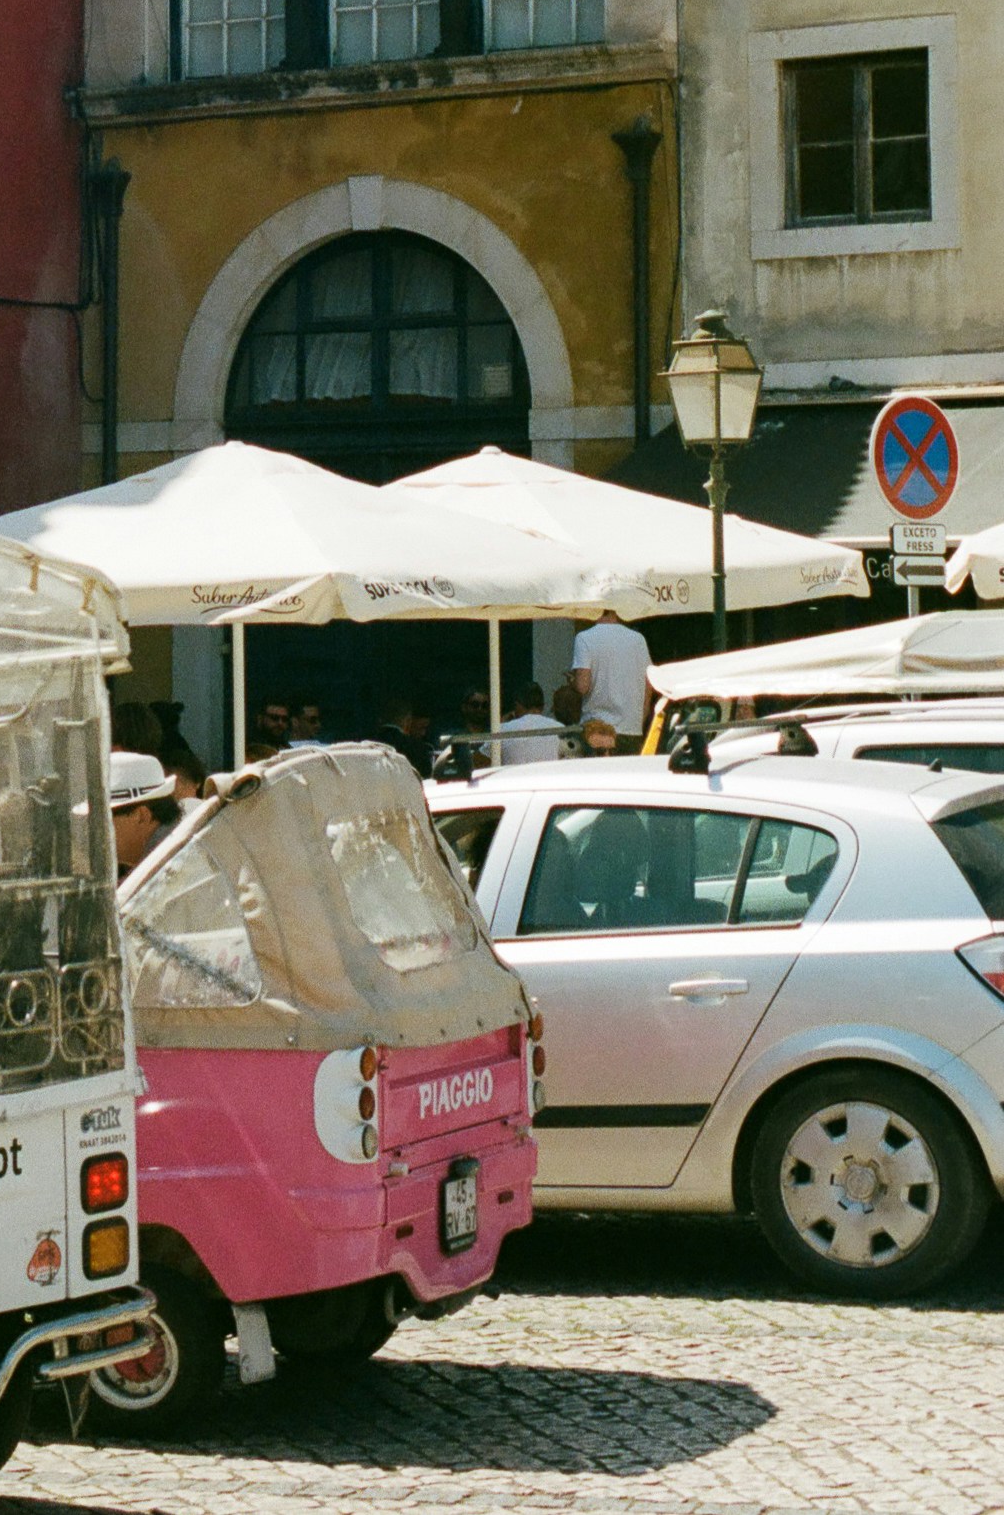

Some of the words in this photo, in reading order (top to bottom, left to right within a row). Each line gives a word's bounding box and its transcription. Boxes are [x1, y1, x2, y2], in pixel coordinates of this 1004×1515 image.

[903, 527, 937, 538] EXCETO
[191, 585, 236, 604] Sabor
[419, 1067, 494, 1120] PIAGGIO
